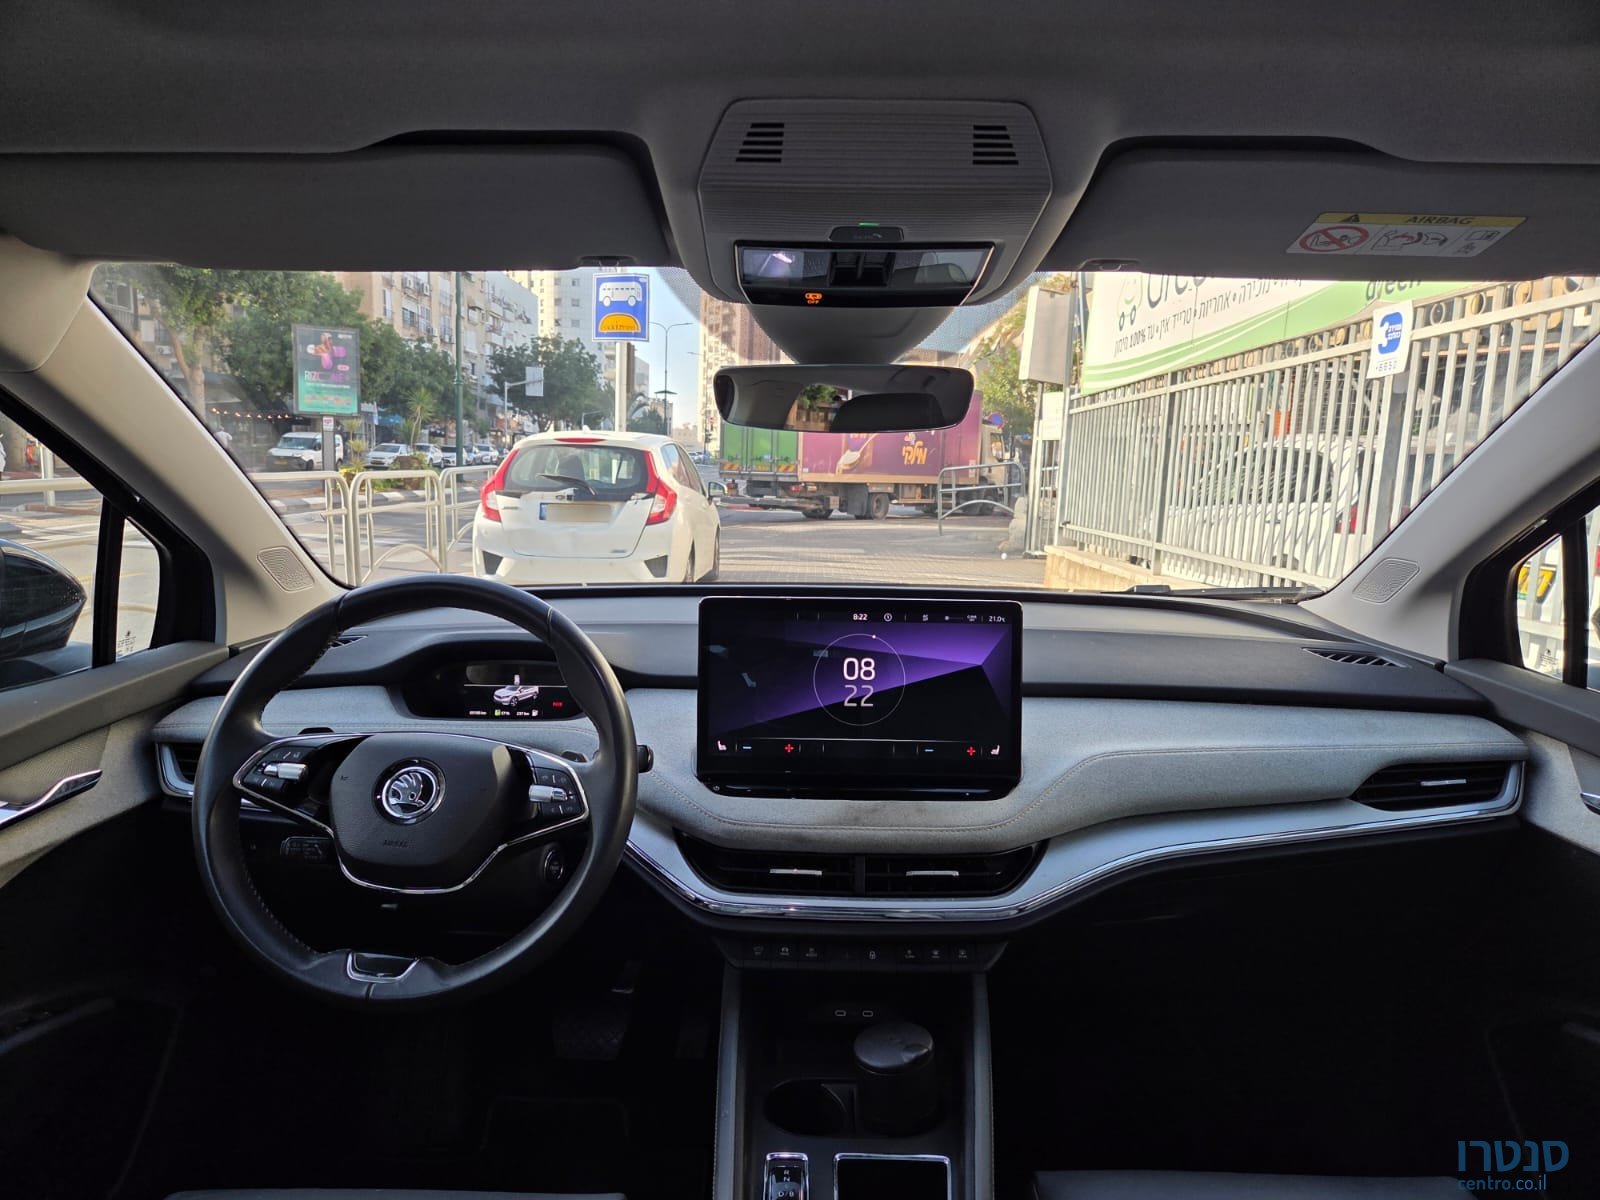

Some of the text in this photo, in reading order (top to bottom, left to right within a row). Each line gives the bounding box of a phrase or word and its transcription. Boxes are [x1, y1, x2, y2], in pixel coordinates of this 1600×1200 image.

[1406, 215, 1474, 225] AIRBAG
[853, 613, 868, 621] 8:22
[843, 657, 876, 681] 08
[843, 684, 875, 707] 22
